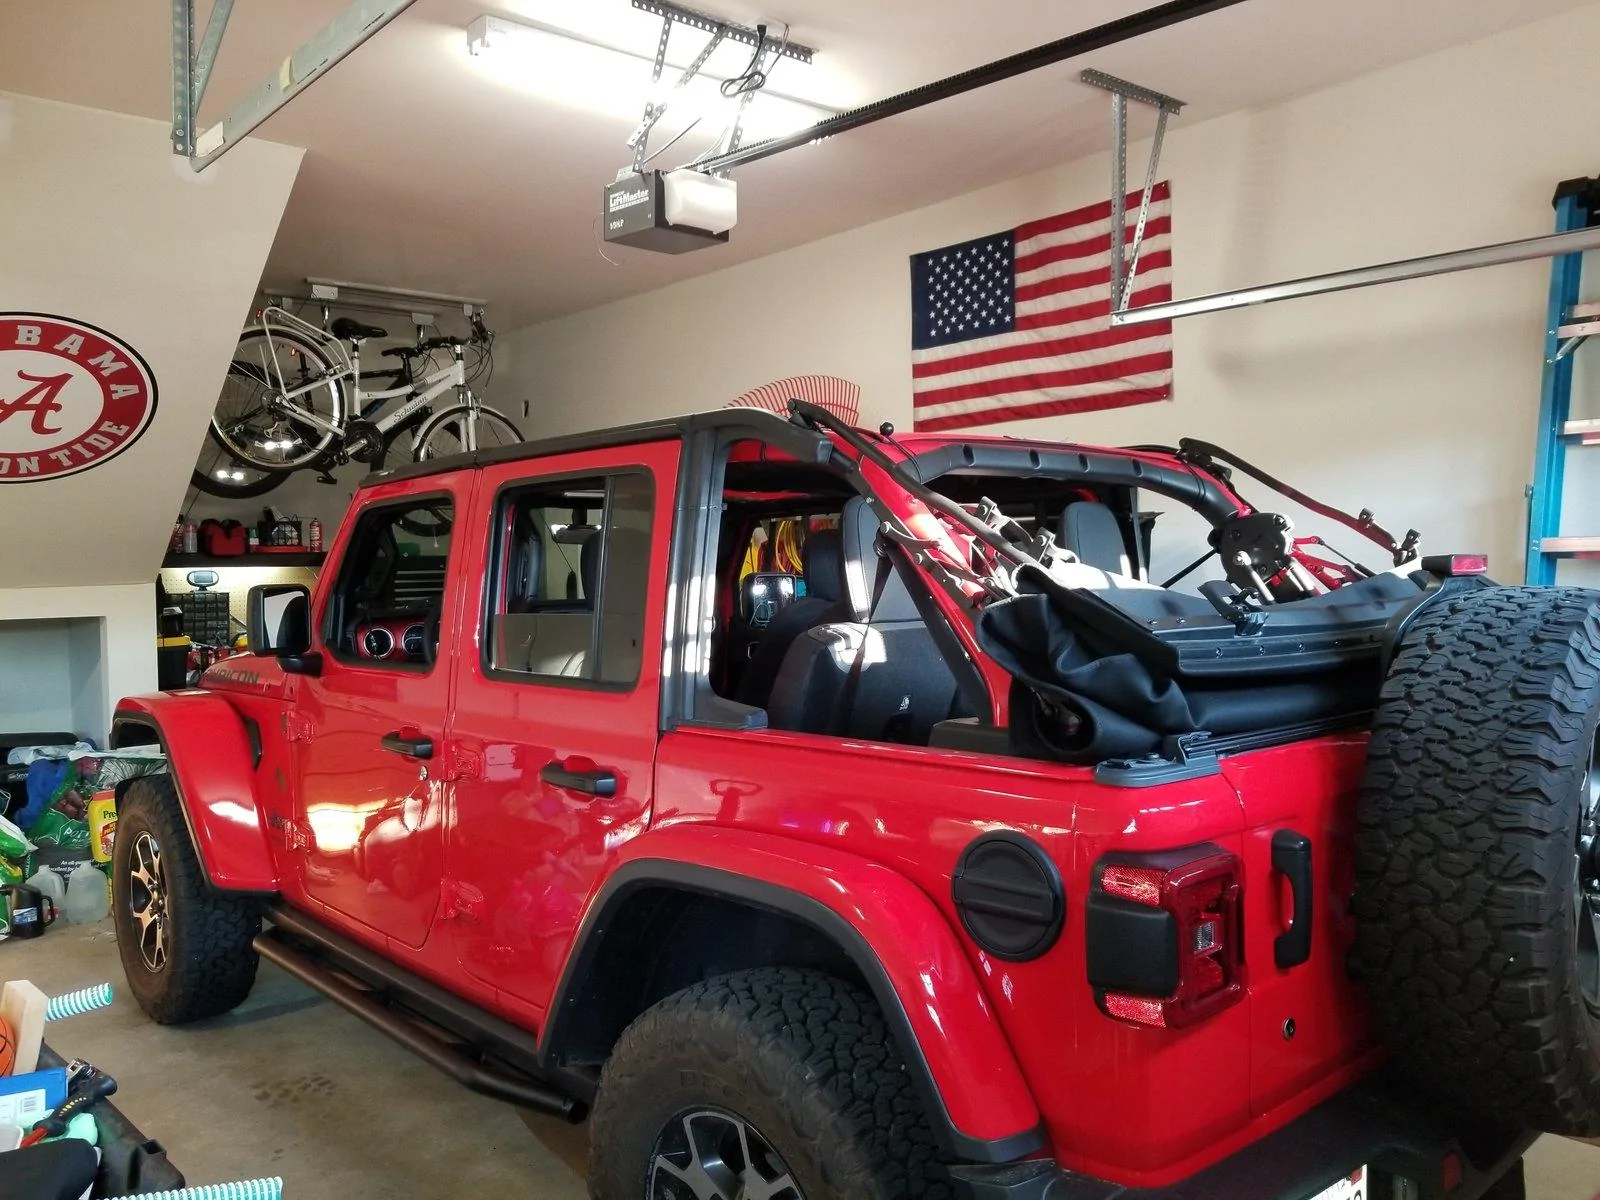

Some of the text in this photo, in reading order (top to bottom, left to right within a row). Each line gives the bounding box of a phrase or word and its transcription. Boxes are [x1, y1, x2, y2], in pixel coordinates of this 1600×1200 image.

[610, 189, 649, 208] LiftMaster
[394, 396, 427, 423] Schwinn
[49, 420, 130, 467] TIDE
